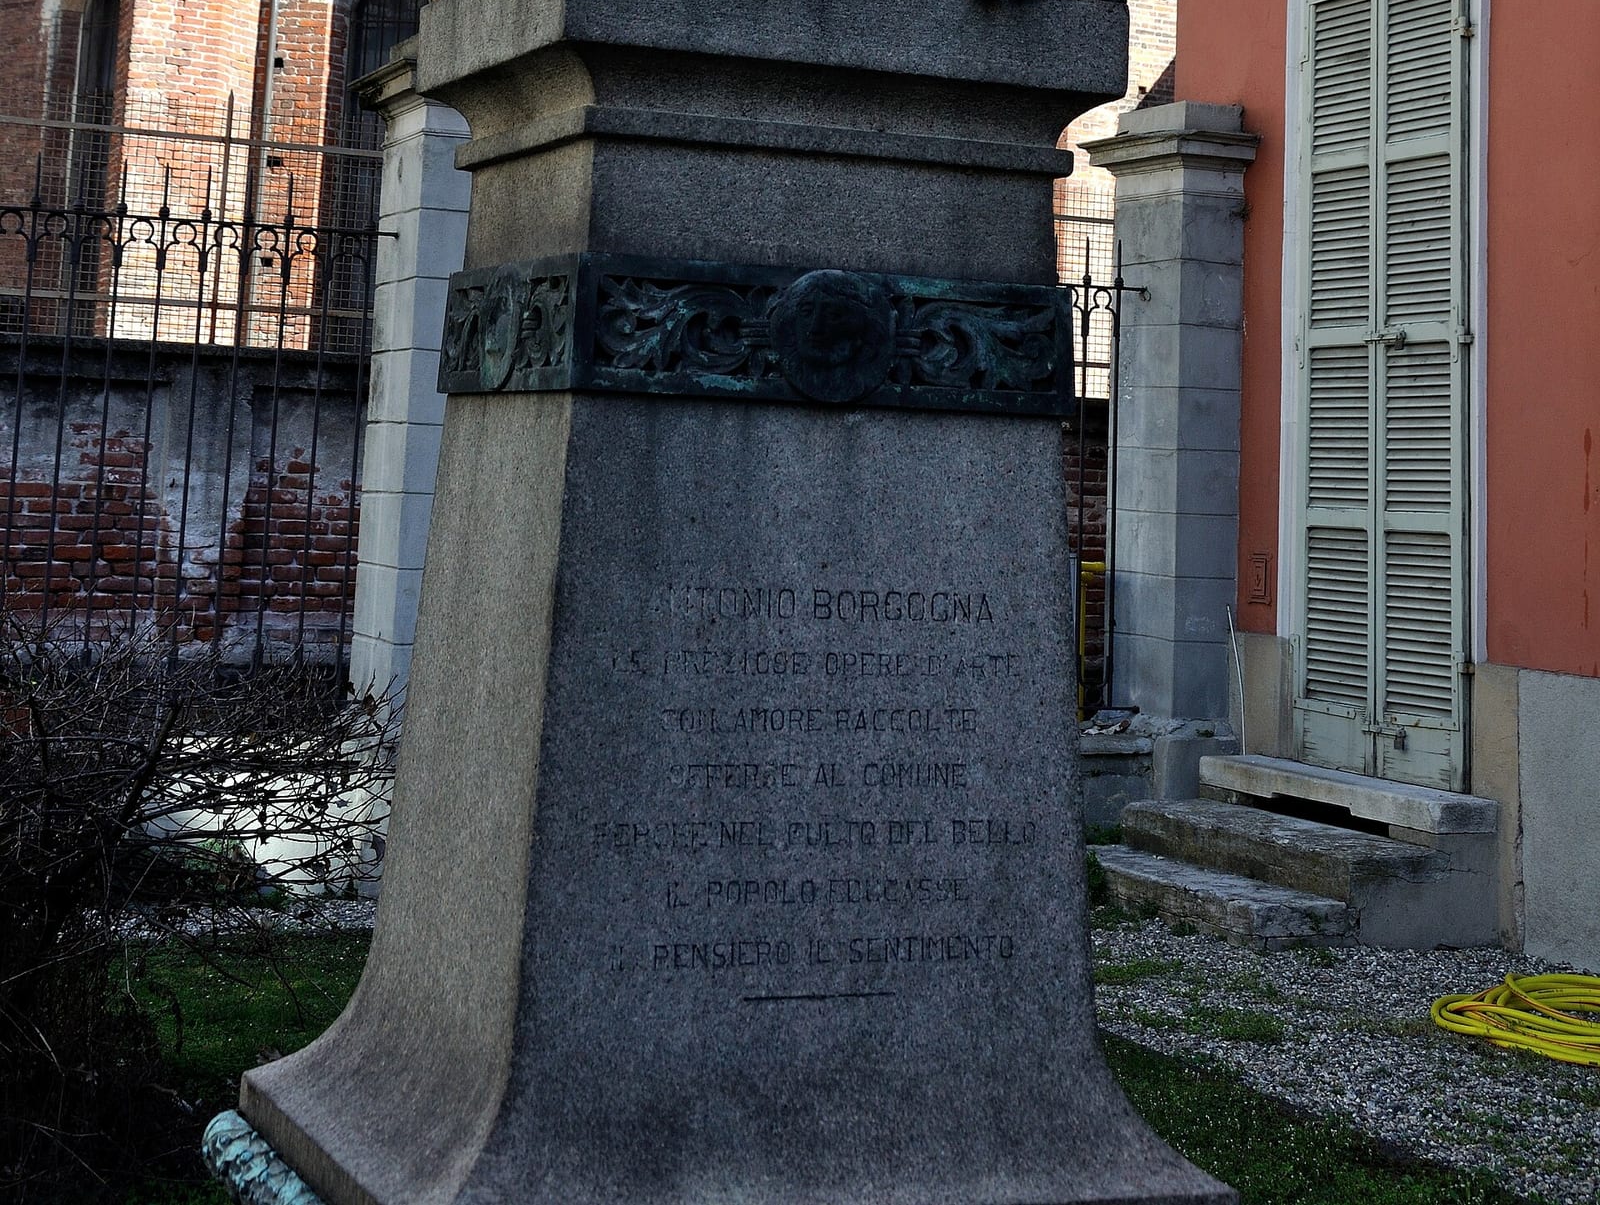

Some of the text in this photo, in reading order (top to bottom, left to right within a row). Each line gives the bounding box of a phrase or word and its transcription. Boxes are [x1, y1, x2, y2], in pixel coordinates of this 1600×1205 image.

[654, 586, 995, 624] NTONIO BORGOGNA
[663, 650, 808, 676] PREZIOSE
[825, 651, 911, 677] OPERE
[732, 707, 823, 733] AMORE
[835, 708, 977, 734] RACCOLTE
[668, 762, 968, 789] OFFERSE AL COMUNE
[719, 820, 773, 847] NEL
[787, 819, 876, 847] CULTO
[888, 819, 938, 846] DEL
[952, 818, 1037, 845] BELLO
[707, 878, 816, 907] POPOLO
[828, 876, 970, 905] EDUCASSE
[653, 936, 791, 971] PENSIERO
[807, 936, 831, 966] IL
[848, 932, 1015, 964] SENTIMENTO
